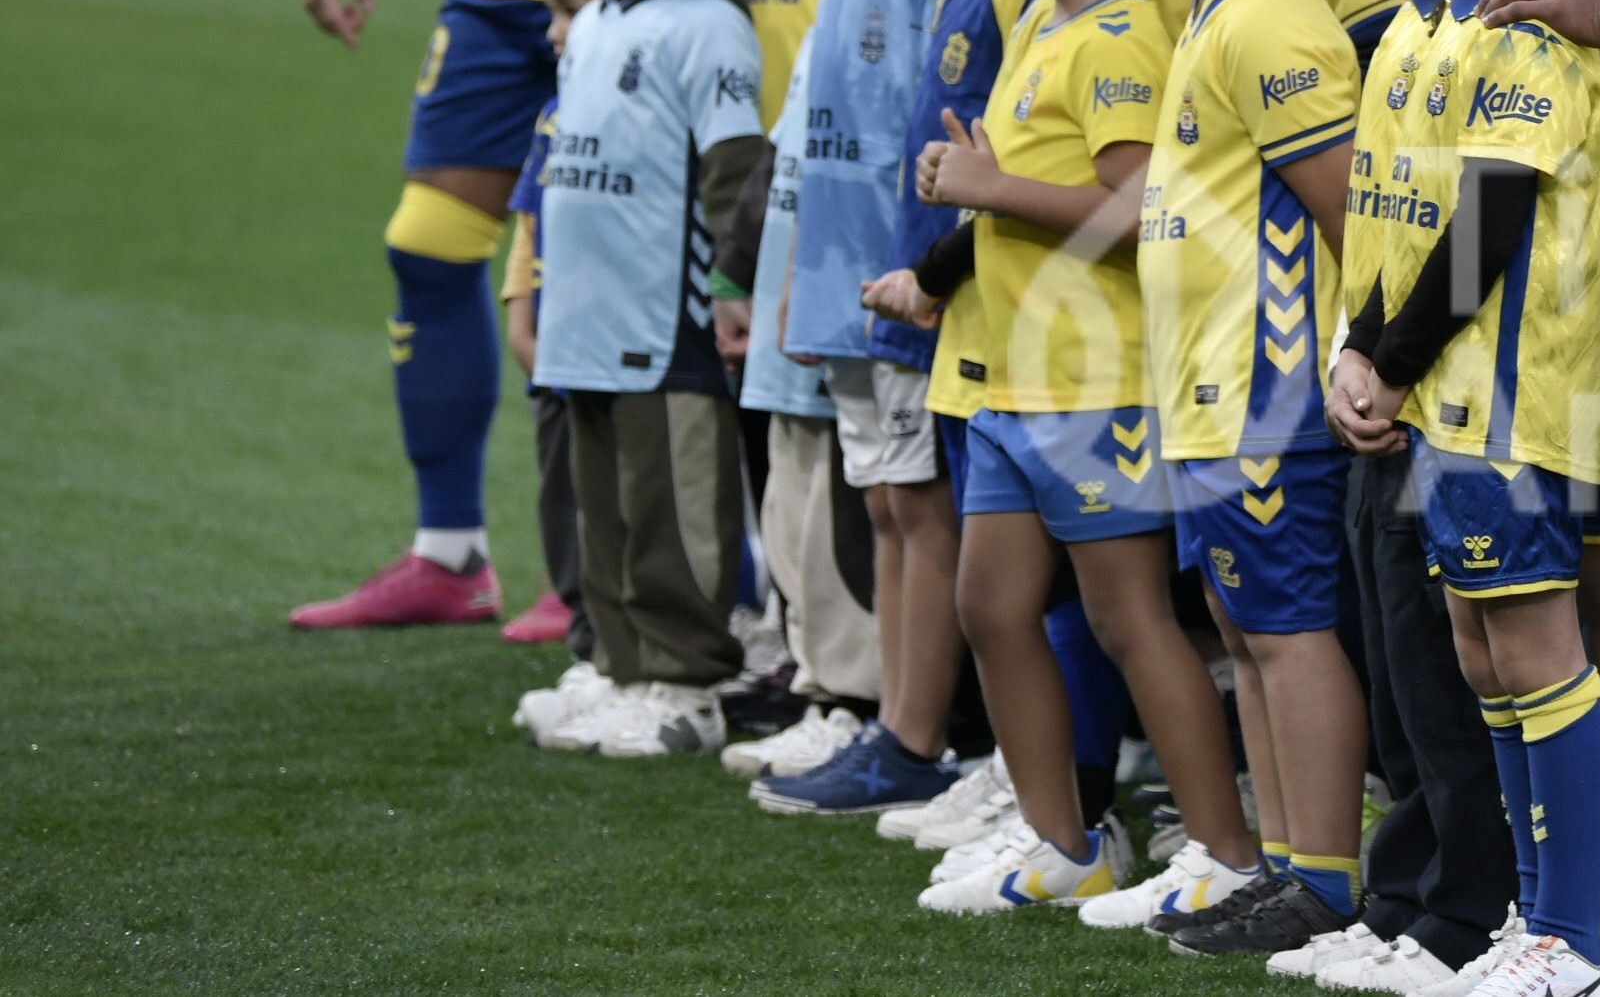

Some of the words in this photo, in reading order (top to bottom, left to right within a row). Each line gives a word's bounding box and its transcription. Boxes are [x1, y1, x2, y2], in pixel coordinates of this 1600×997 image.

[1094, 76, 1152, 114] Kalise
[1259, 68, 1319, 110] Kalise
[1466, 77, 1552, 127] Kalise
